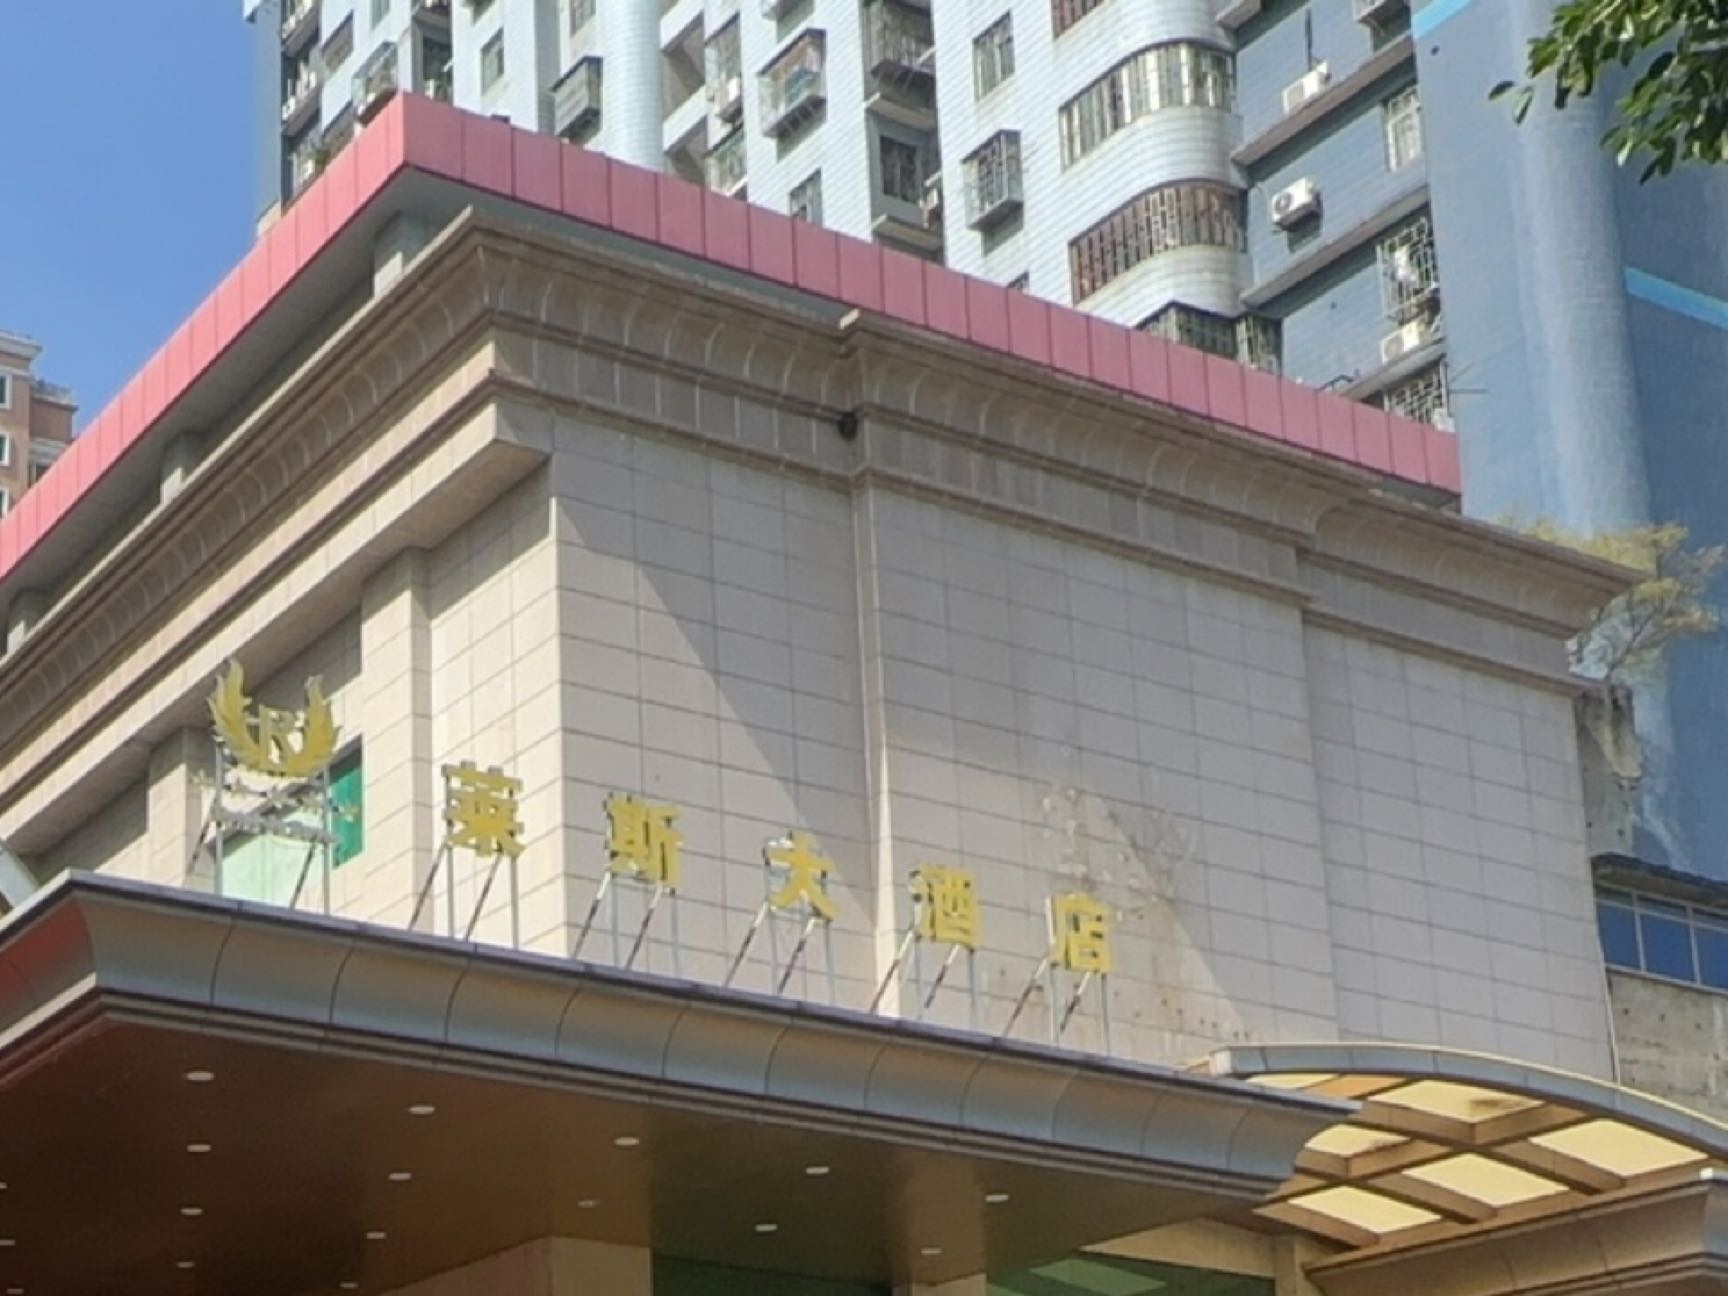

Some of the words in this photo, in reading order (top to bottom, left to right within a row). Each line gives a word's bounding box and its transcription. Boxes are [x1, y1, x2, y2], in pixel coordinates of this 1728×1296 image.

[442, 761, 1114, 974] 莱斯大酒店
